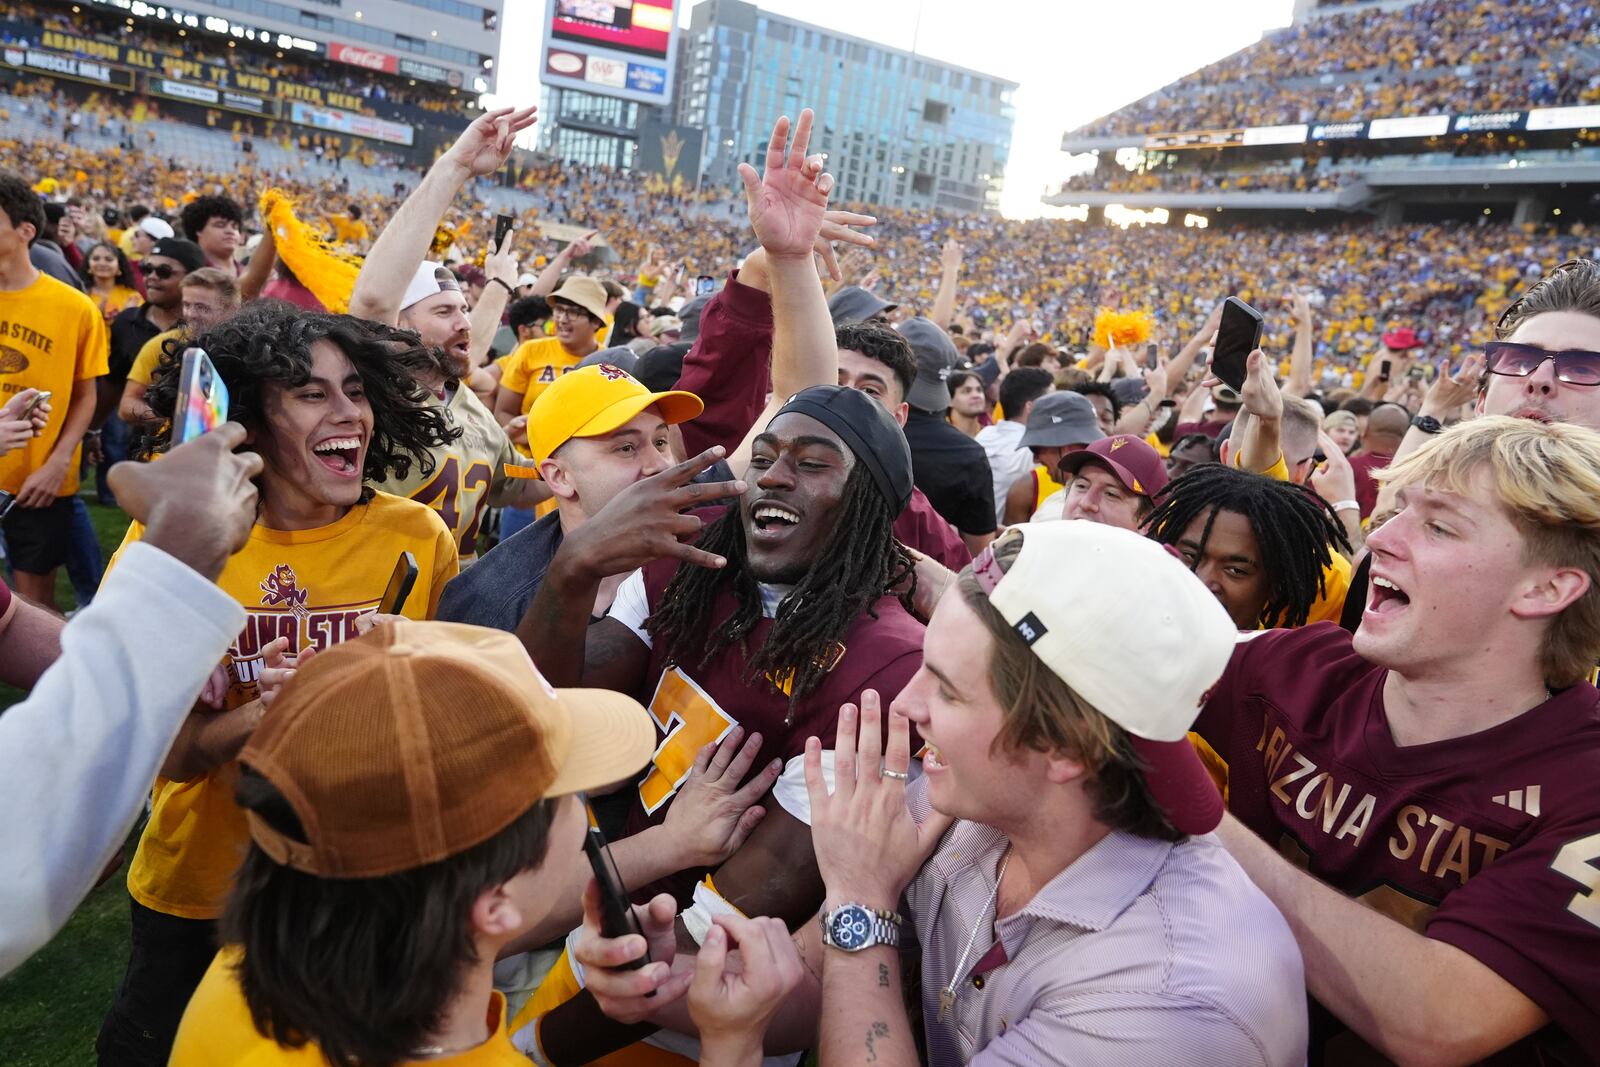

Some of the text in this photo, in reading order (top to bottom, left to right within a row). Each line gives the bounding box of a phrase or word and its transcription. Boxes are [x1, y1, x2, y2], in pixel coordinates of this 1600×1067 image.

[126, 48, 155, 69] ALL
[236, 72, 270, 92] WHO
[327, 91, 362, 111] HERE
[339, 46, 385, 70] Coca-Cola
[11, 322, 53, 354] STATE
[406, 454, 493, 557] 42
[638, 664, 739, 816] 7
